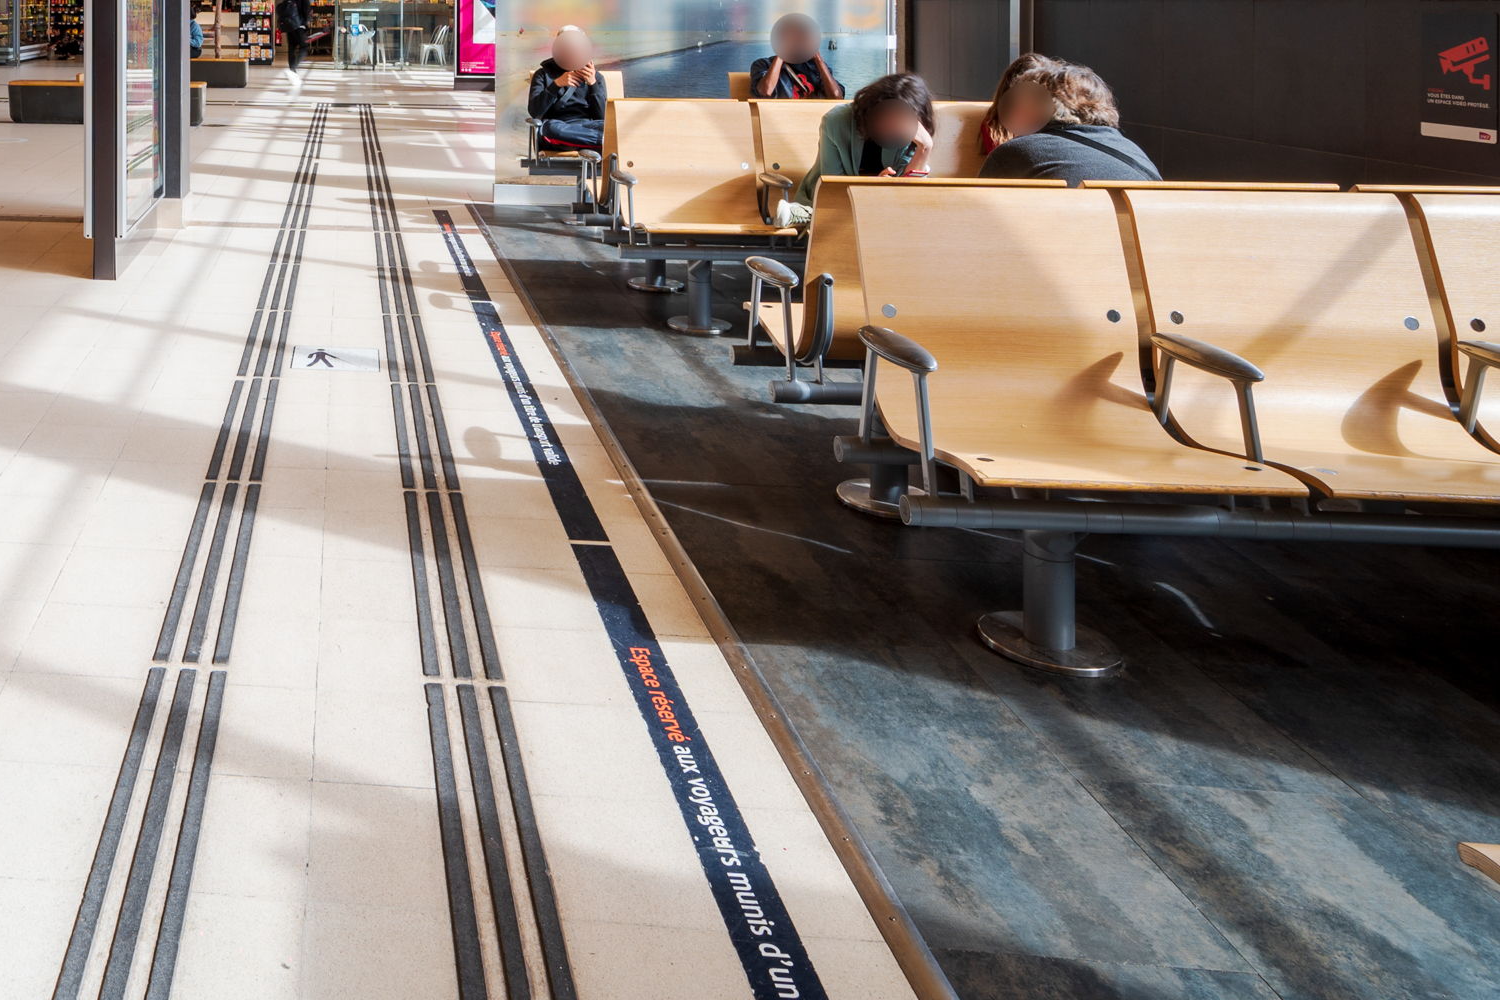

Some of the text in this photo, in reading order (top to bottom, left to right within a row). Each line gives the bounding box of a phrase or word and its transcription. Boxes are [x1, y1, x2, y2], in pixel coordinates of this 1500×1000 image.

[532, 423, 553, 447] transport
[543, 448, 562, 466] valide
[629, 647, 661, 688] Espace
[649, 690, 692, 743] réservé
[673, 745, 701, 774] aux
[687, 777, 742, 867] voyageurs
[727, 871, 775, 936] munis
